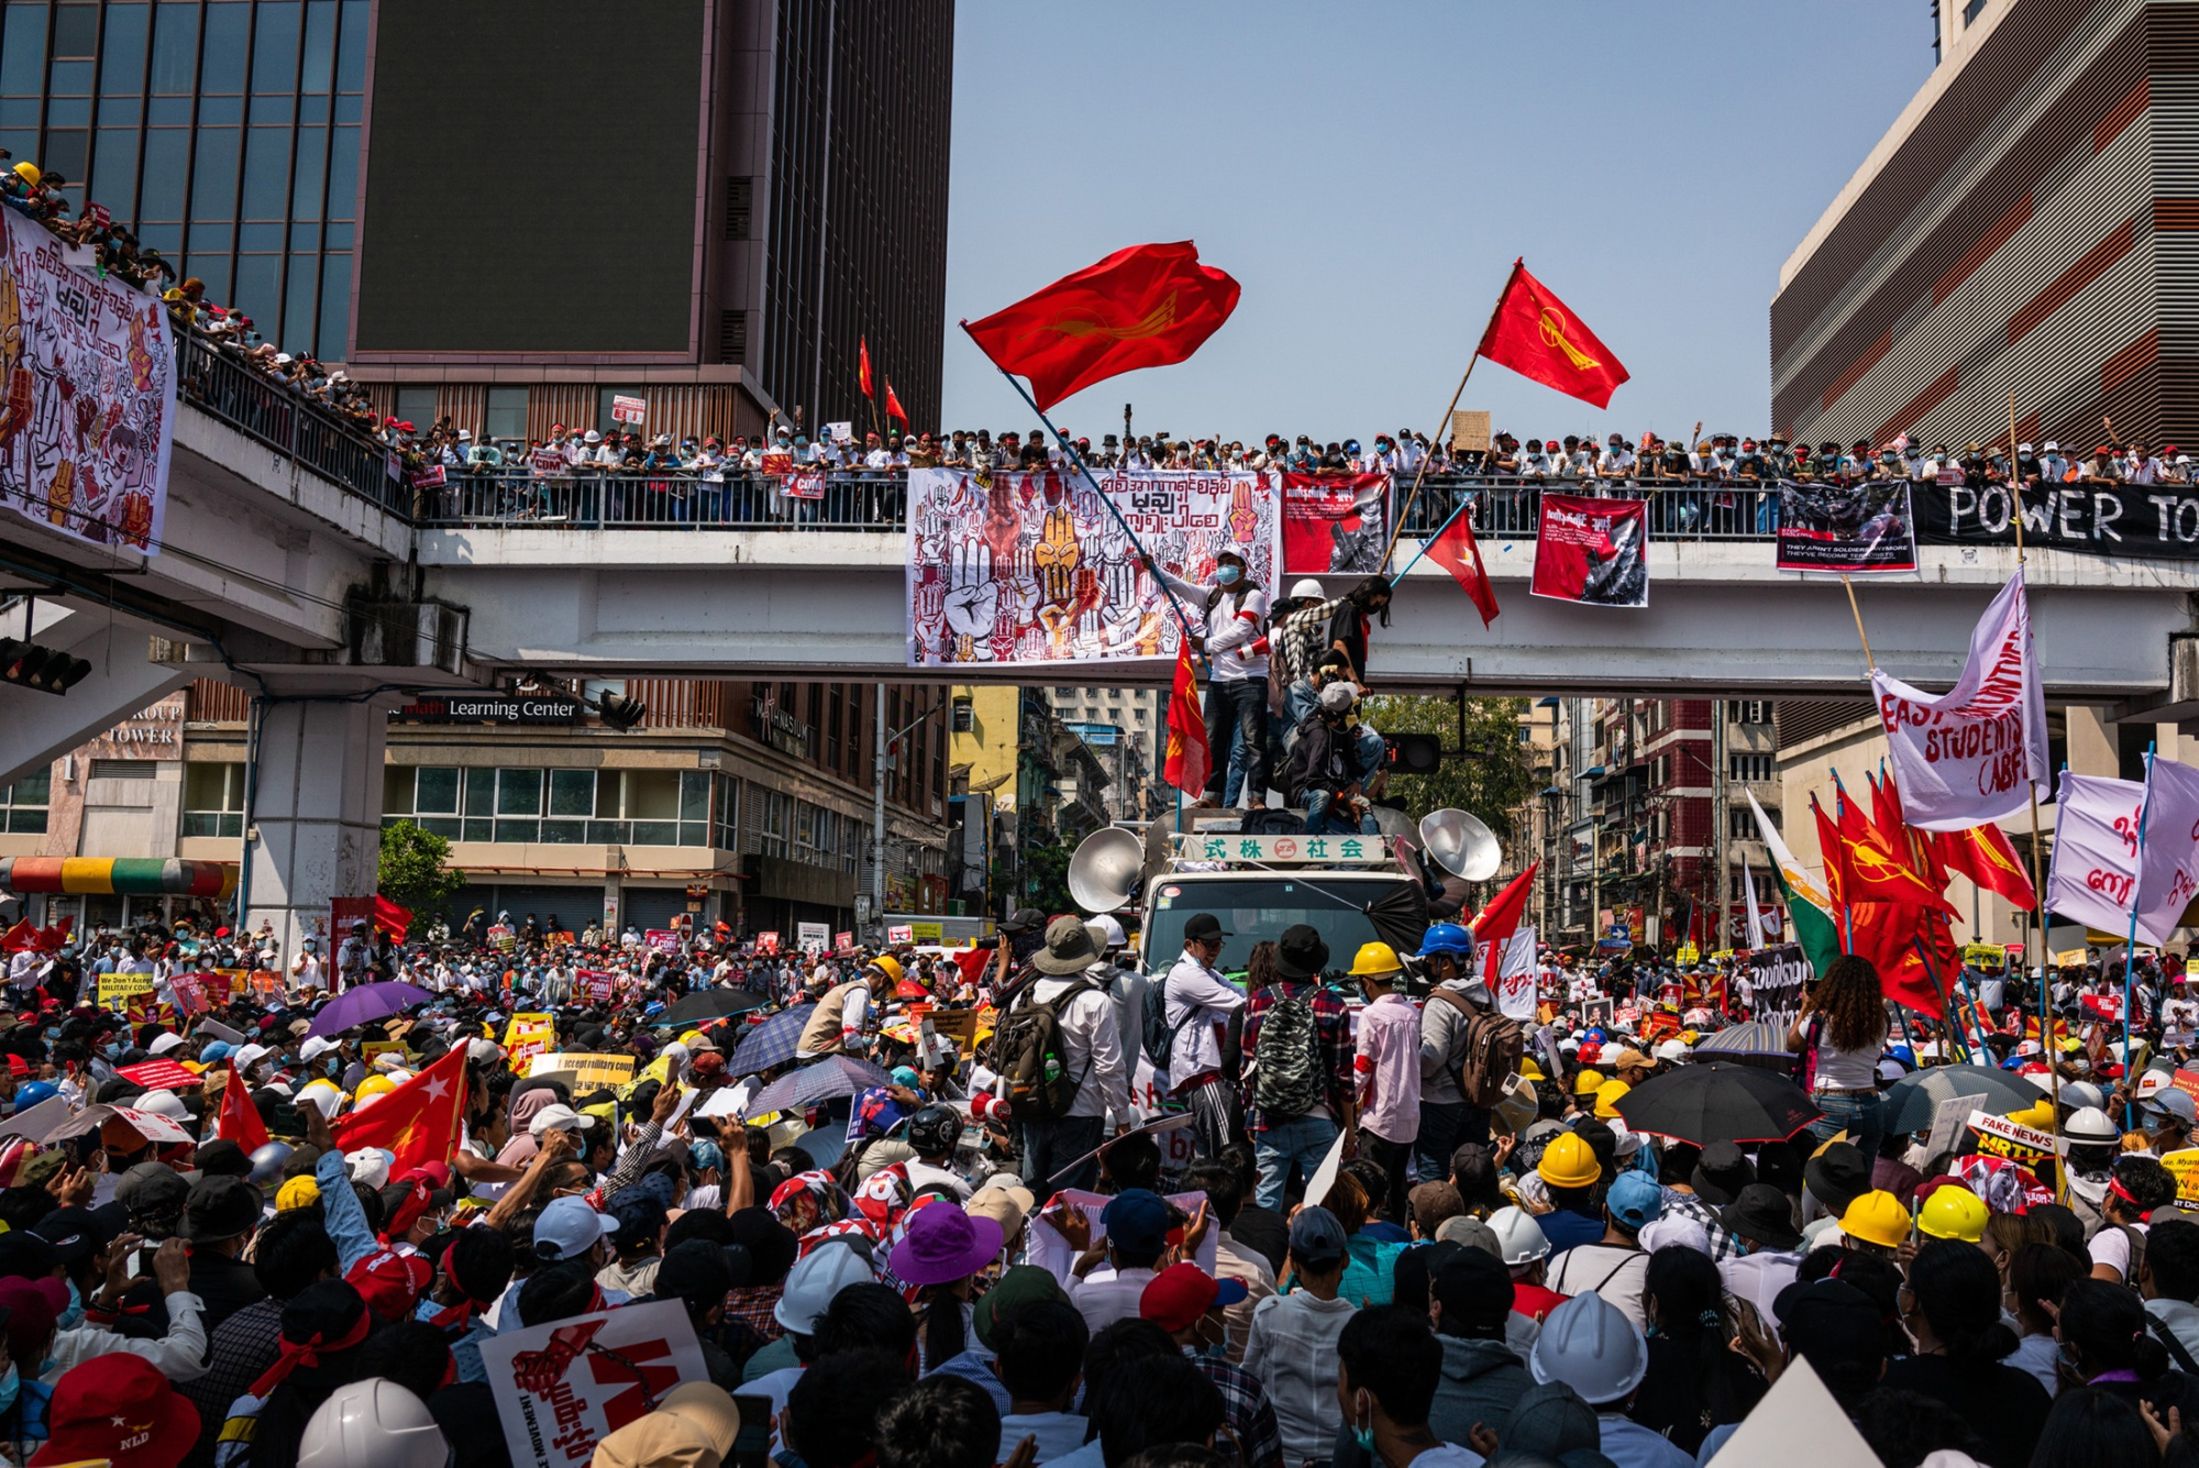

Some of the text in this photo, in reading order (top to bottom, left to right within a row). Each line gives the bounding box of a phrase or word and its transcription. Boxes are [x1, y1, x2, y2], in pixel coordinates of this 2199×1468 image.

[1950, 485, 2123, 542] POWER
[450, 701, 520, 719] Learning
[523, 701, 576, 717] Center
[110, 728, 172, 743] TOWER
[132, 977, 153, 985] Accep
[616, 1062, 633, 1072] coup
[1981, 1117, 2054, 1148] FAKE NEWS
[1977, 1132, 2045, 1167] MRTV
[519, 1394, 547, 1459] MOVEMENT
[120, 1431, 149, 1450] NLD
